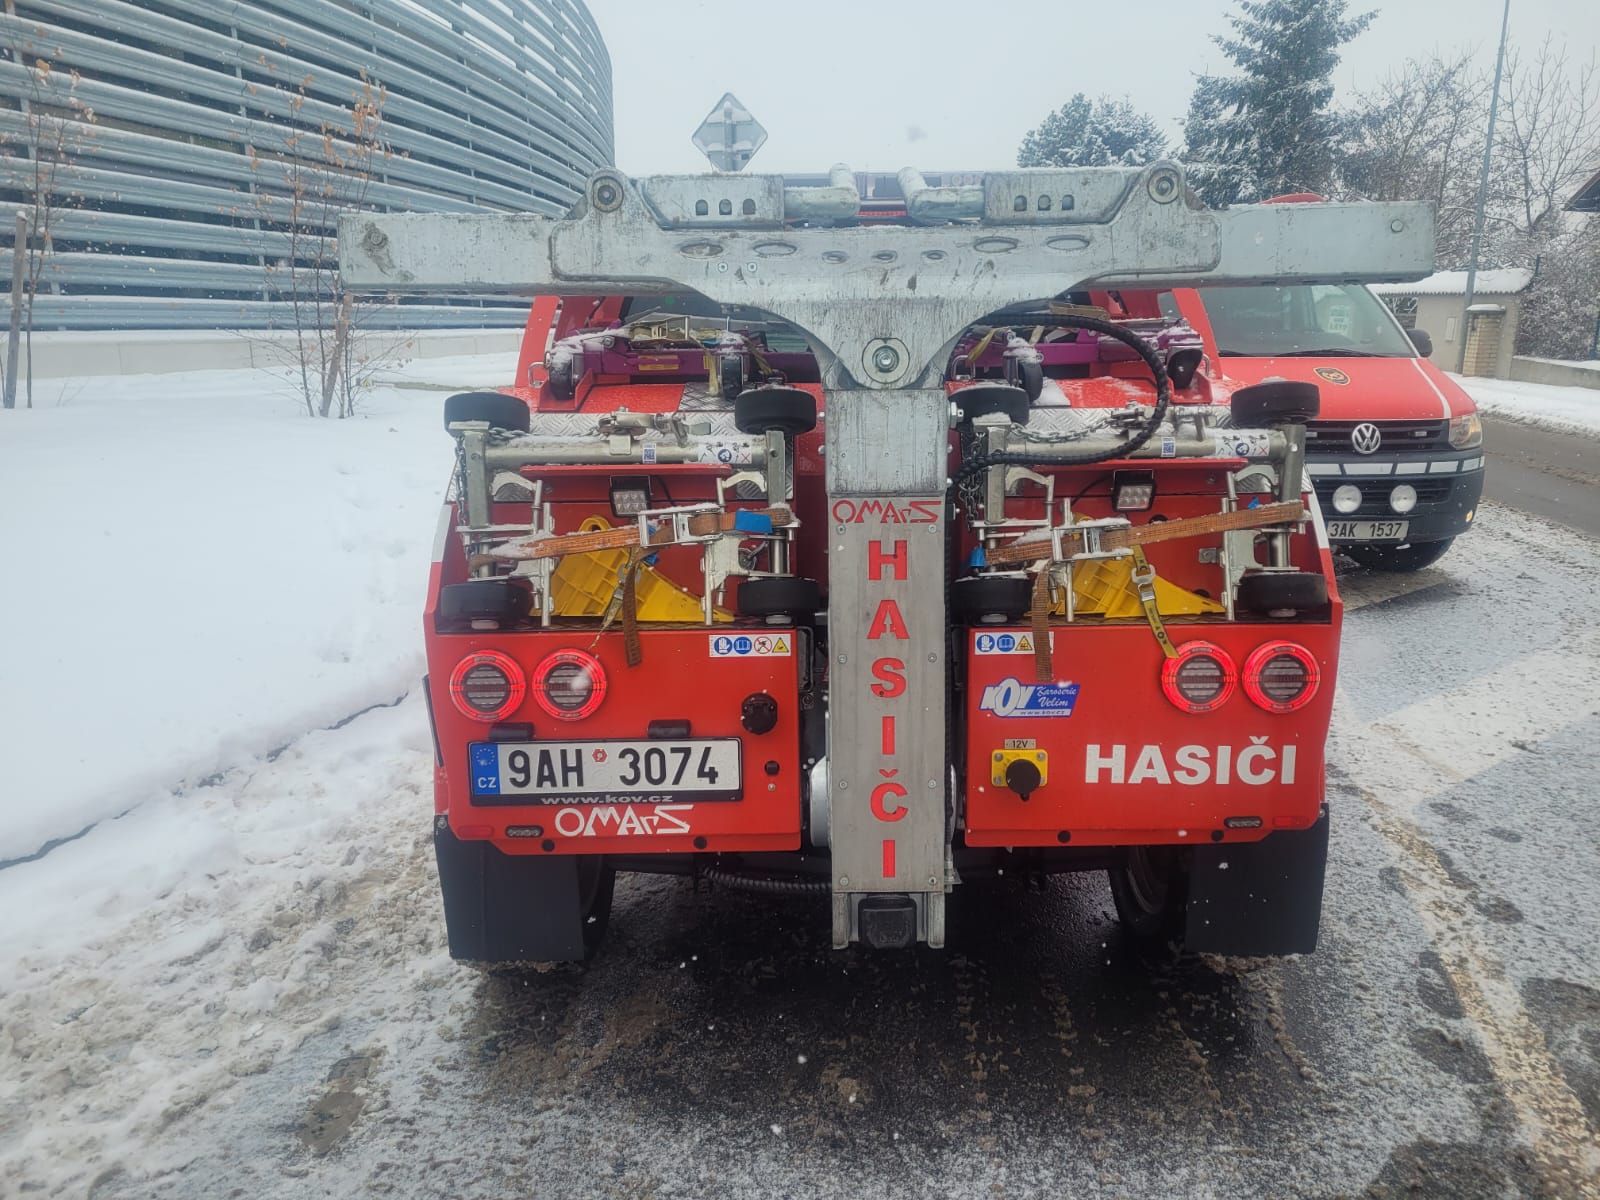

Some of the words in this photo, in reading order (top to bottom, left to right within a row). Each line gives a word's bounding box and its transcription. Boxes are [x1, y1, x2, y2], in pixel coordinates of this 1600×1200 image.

[1329, 523, 1358, 538] 3AK
[1369, 521, 1402, 537] 1537
[1038, 697, 1069, 708] Velim
[1012, 740, 1029, 748] 12V
[1085, 736, 1297, 785] HASIČI
[508, 748, 584, 788] 9AH
[618, 746, 719, 786] 3074
[478, 777, 497, 789] CZ
[541, 794, 673, 804] www.kov.cz
